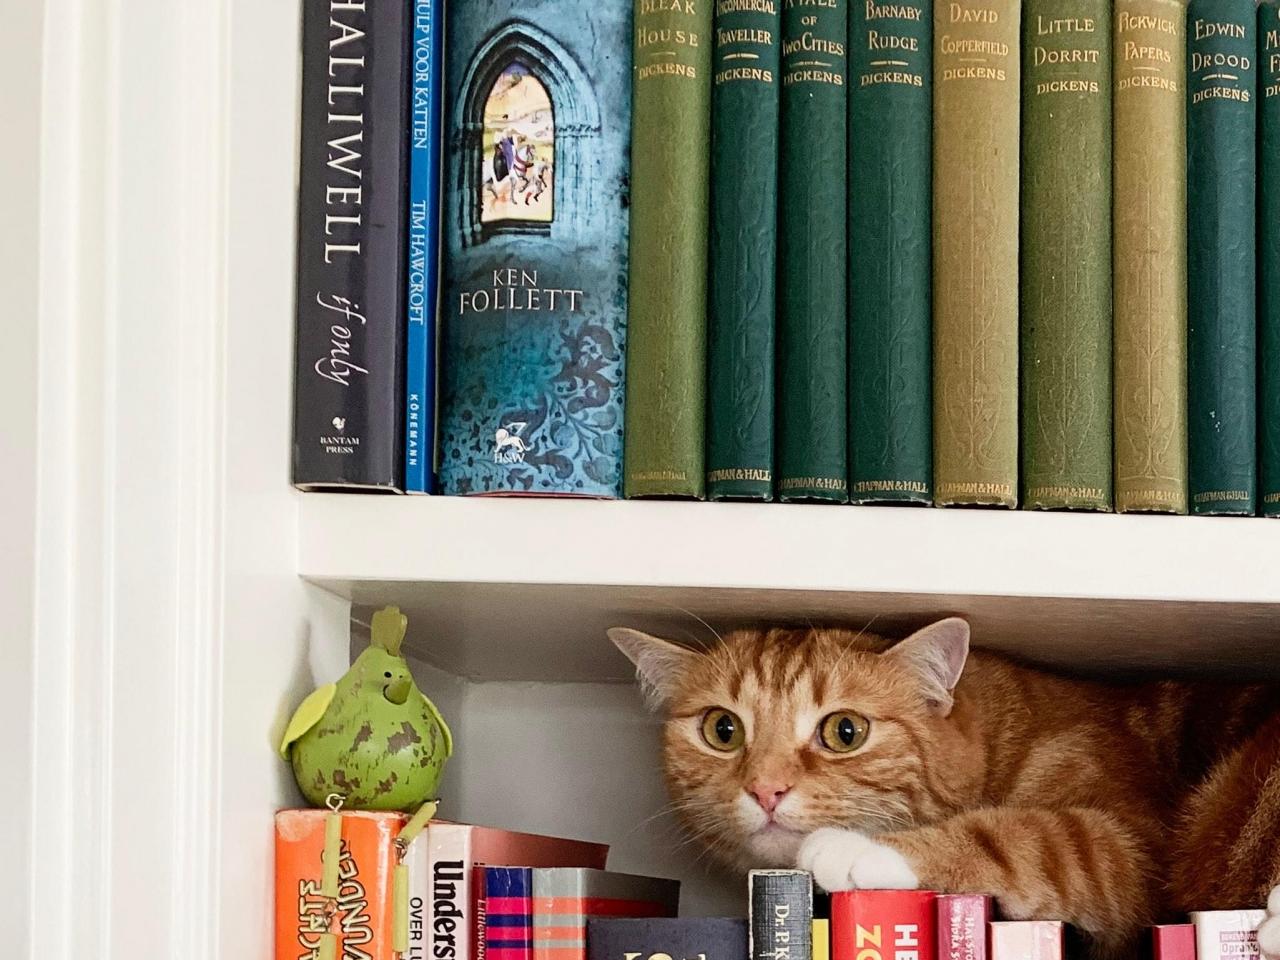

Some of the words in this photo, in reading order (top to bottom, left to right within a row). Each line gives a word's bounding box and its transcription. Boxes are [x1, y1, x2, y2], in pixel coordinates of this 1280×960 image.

[1037, 16, 1095, 36] LITTLE
[1195, 19, 1246, 41] EDWIN
[415, 37, 430, 83] VOOR
[1034, 46, 1100, 66] DORRIT
[1192, 52, 1250, 73] DROOD
[1036, 80, 1099, 96] DICKENS
[1192, 86, 1251, 104] DICKENS
[413, 87, 428, 149] KATTEN
[412, 200, 427, 231] TIM
[409, 233, 426, 325] HAWCROFT
[492, 268, 538, 287] KEN
[317, 291, 366, 326] if
[459, 288, 584, 314] FOLLETT
[316, 326, 369, 386] only
[408, 393, 419, 466] KÖNEMANN
[319, 436, 360, 446] BANTAM
[325, 444, 354, 454] PRESS
[493, 451, 526, 463] H&W
